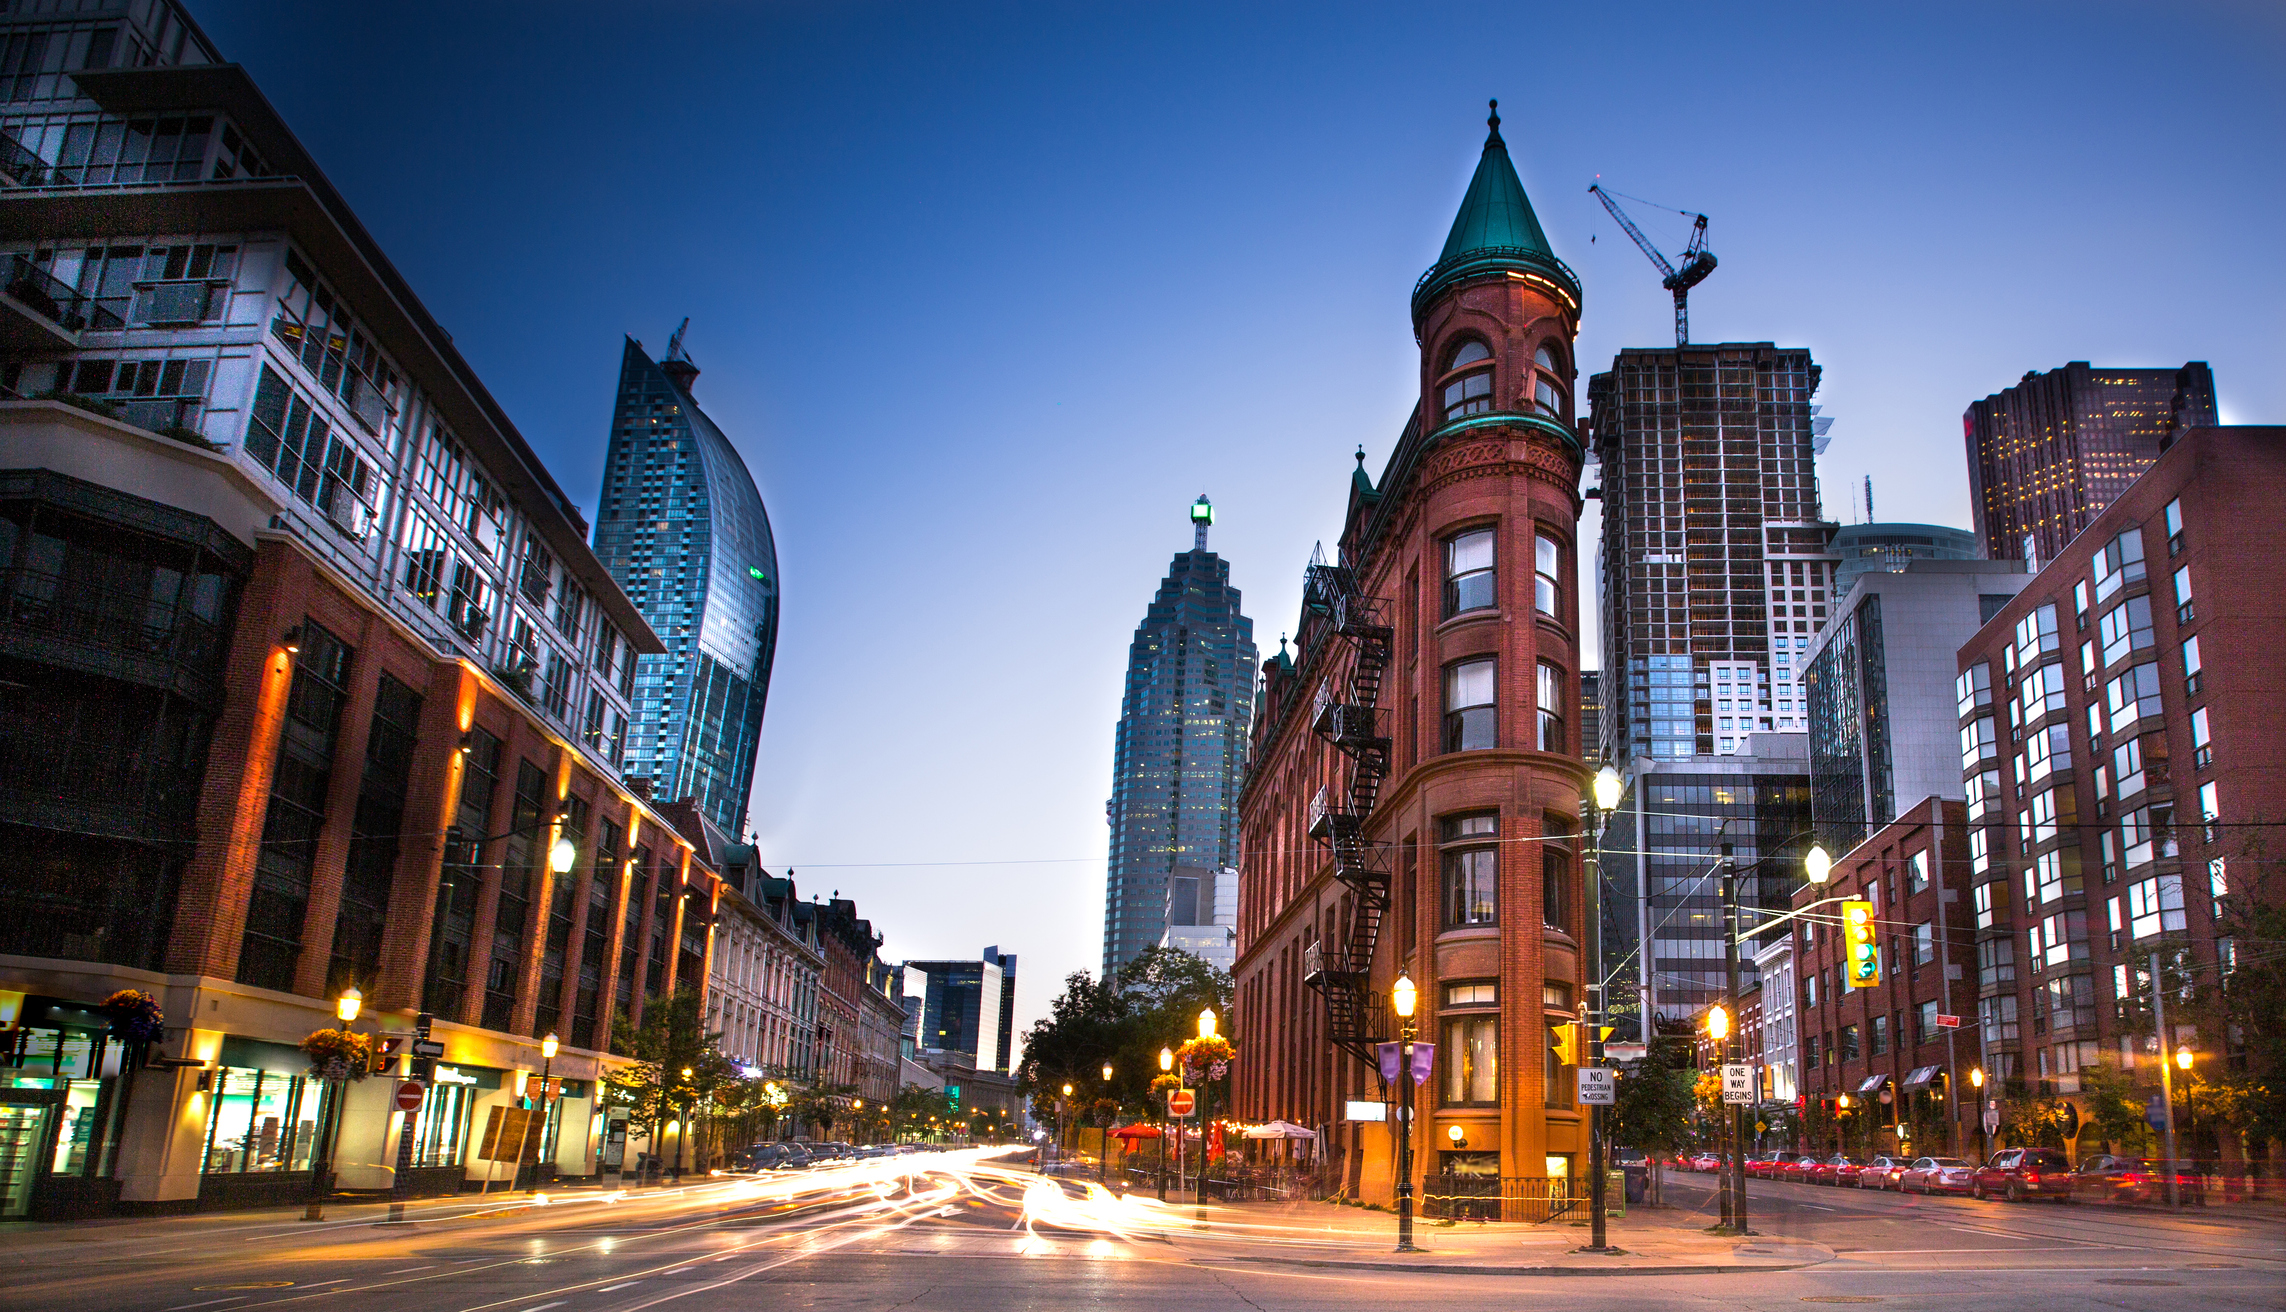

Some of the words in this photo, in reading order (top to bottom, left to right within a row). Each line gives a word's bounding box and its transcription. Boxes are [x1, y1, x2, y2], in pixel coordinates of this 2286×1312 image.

[1590, 1072, 1603, 1082] NO
[1730, 1068, 1745, 1077] ONE
[1730, 1080, 1745, 1088] WAY
[1725, 1091, 1752, 1100] BEGINS
